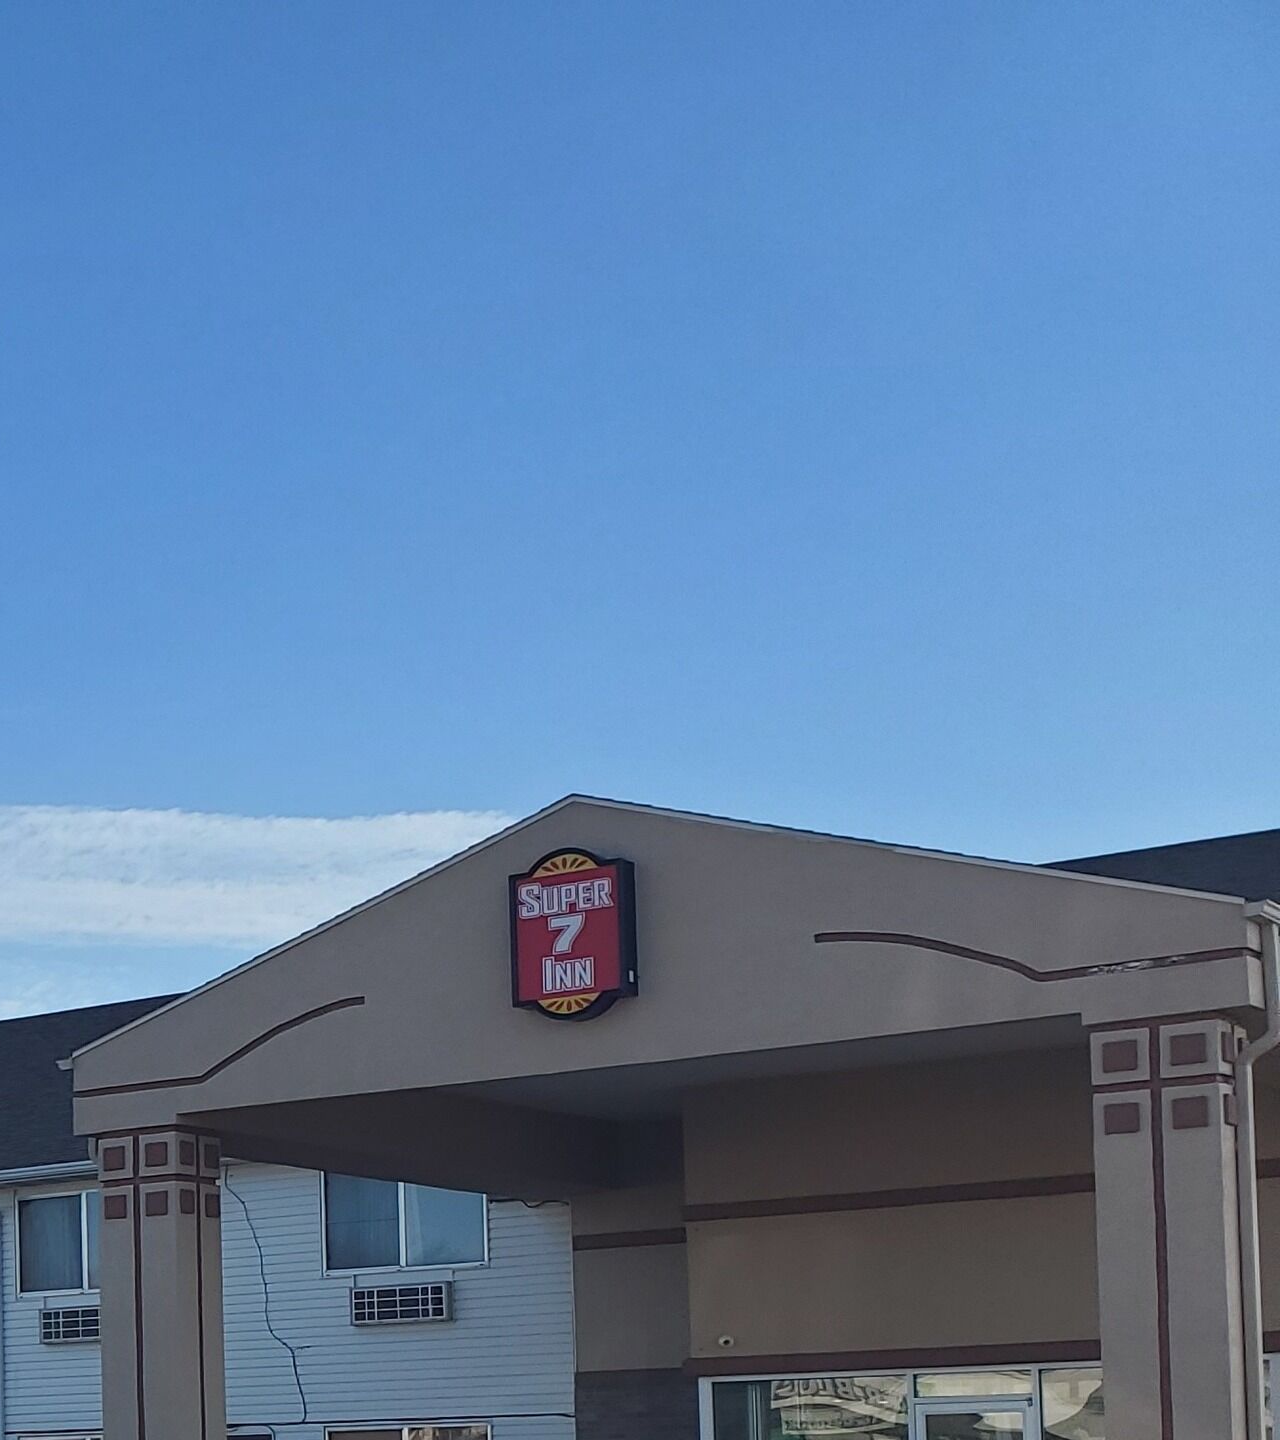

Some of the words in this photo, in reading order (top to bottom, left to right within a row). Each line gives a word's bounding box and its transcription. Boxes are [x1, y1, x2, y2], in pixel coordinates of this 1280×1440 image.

[518, 877, 614, 919] SUPER
[547, 912, 585, 955] 7
[542, 956, 595, 993] INN
